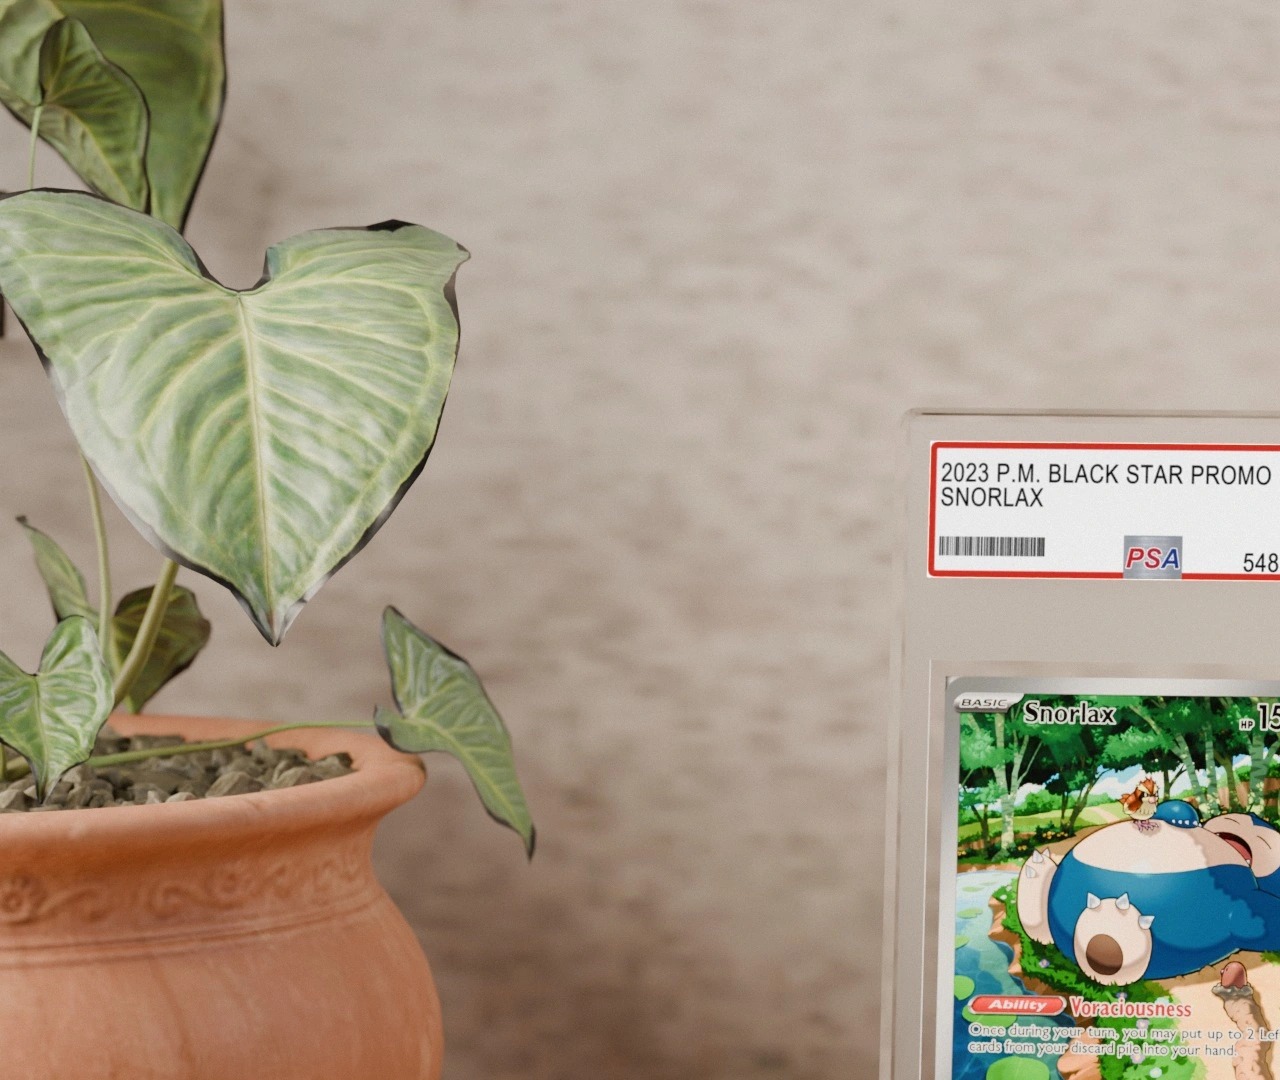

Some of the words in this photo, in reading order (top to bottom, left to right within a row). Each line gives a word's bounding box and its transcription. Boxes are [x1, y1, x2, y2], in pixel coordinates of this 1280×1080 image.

[942, 463, 988, 482] 2023
[998, 464, 1039, 482] P.M.
[1050, 464, 1118, 483] BLACK
[1127, 465, 1182, 484] STAR
[1192, 466, 1271, 485] PROMO
[942, 487, 1042, 506] SNORLAX
[1125, 546, 1180, 570] PSA
[960, 697, 1008, 709] BASIC
[1024, 701, 1117, 725] Snorlax
[1240, 718, 1254, 730] HP
[987, 998, 1048, 1012] Ability
[1071, 998, 1192, 1018] Voraciousness
[969, 1023, 1007, 1037] Once
[1009, 1024, 1051, 1039] during
[1052, 1026, 1086, 1040] your
[1088, 1025, 1120, 1039] turn,
[1123, 1028, 1148, 1043] you
[1151, 1029, 1179, 1043] may
[1181, 1029, 1203, 1043] put
[1207, 1030, 1225, 1043] up
[1228, 1029, 1242, 1040] to
[1247, 1028, 1255, 1040] 2
